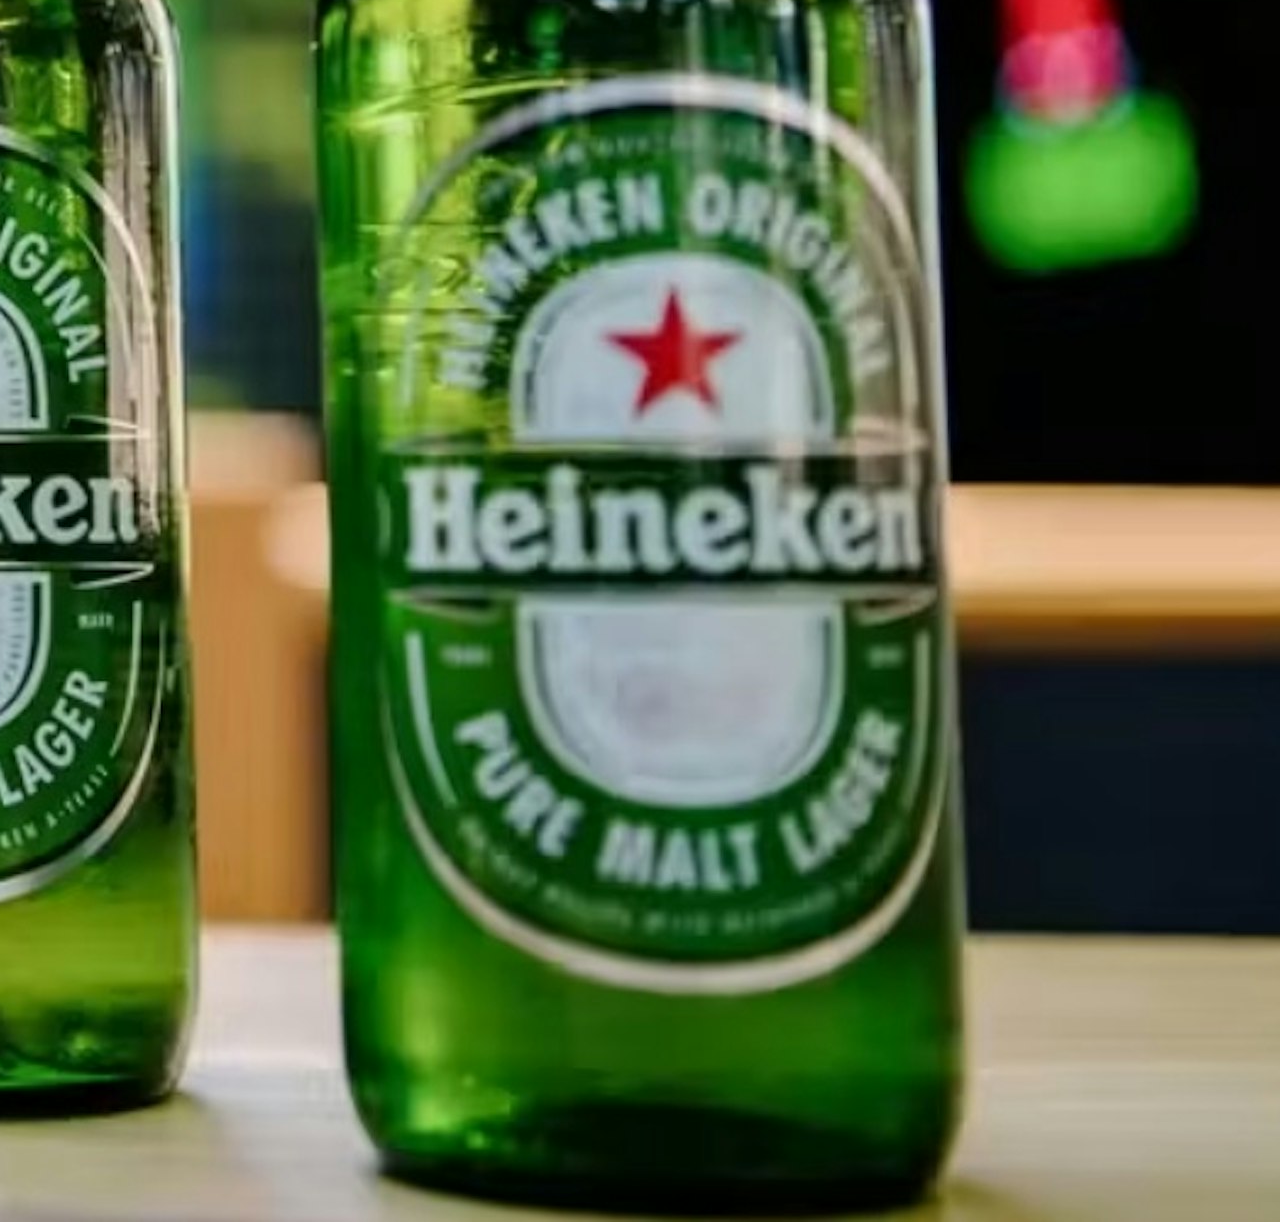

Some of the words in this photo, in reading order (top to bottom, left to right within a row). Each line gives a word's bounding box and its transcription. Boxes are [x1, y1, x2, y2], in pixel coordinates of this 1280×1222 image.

[404, 464, 922, 573] Heineken
[453, 709, 584, 858] PURE
[595, 816, 761, 892] MALT
[779, 708, 903, 873] LAGER
